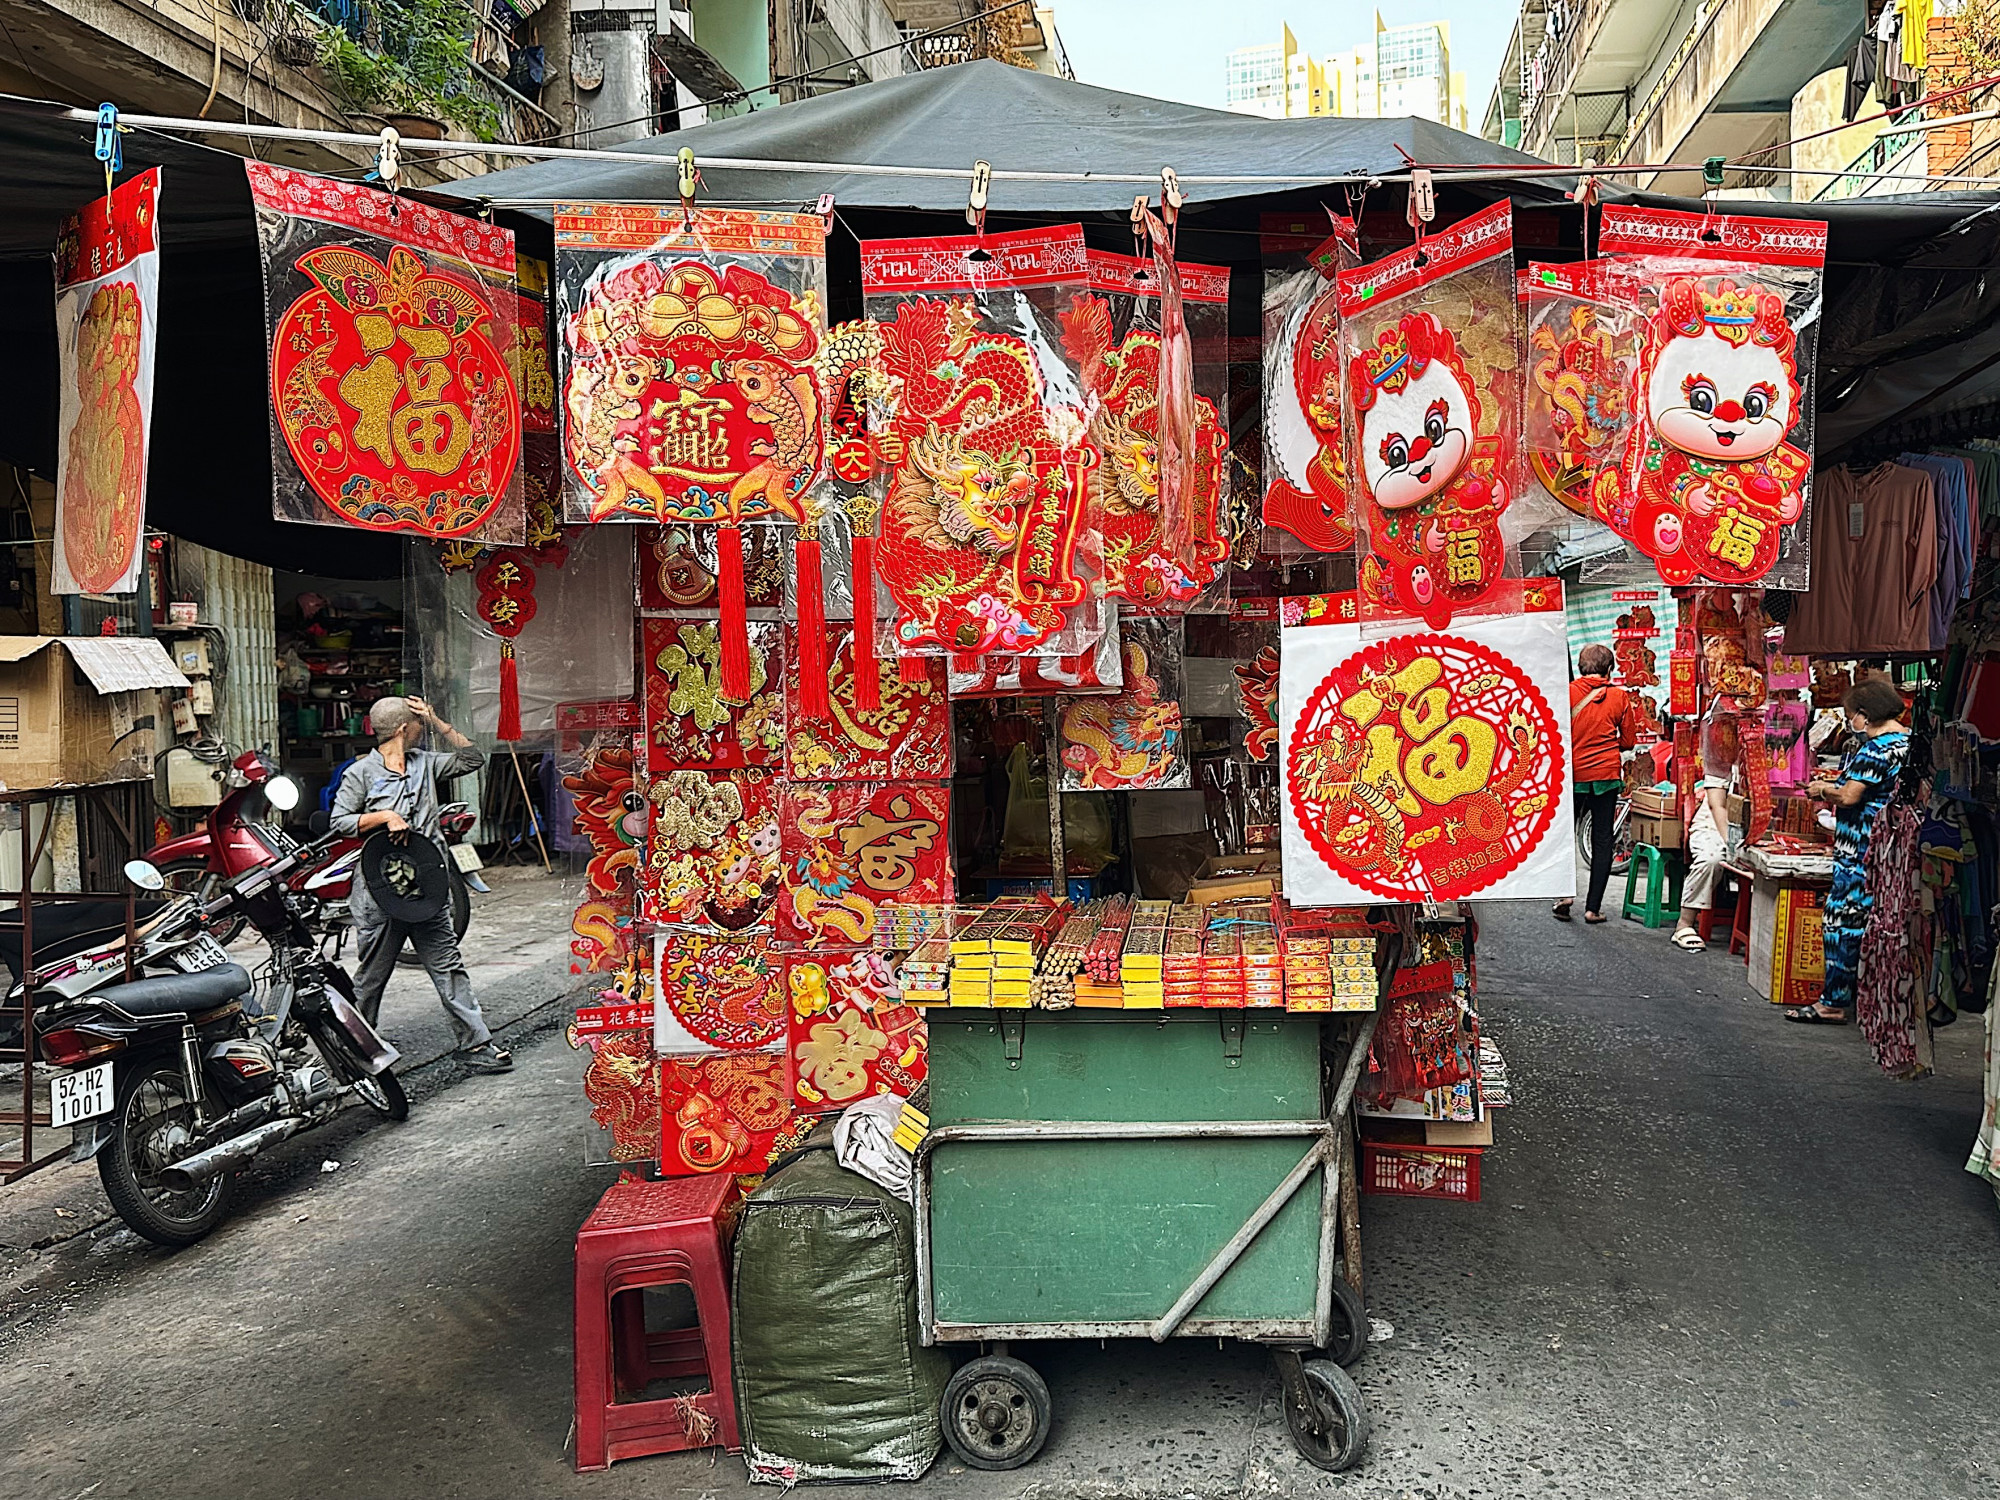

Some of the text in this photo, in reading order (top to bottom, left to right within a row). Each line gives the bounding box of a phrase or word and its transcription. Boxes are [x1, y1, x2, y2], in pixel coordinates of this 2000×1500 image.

[352, 281, 371, 304] 富
[667, 340, 718, 359] 代代有福
[1575, 348, 1595, 374] 旺
[338, 314, 474, 475] 福
[838, 447, 870, 473] 大
[1445, 528, 1482, 584] 福
[1709, 507, 1767, 569] 福
[490, 561, 522, 625] 平安
[1340, 656, 1498, 818] 福
[1430, 842, 1508, 887] 吉祥如意
[608, 1010, 640, 1026] 花季
[795, 1008, 889, 1101] 福
[60, 1091, 103, 1122] 1001
